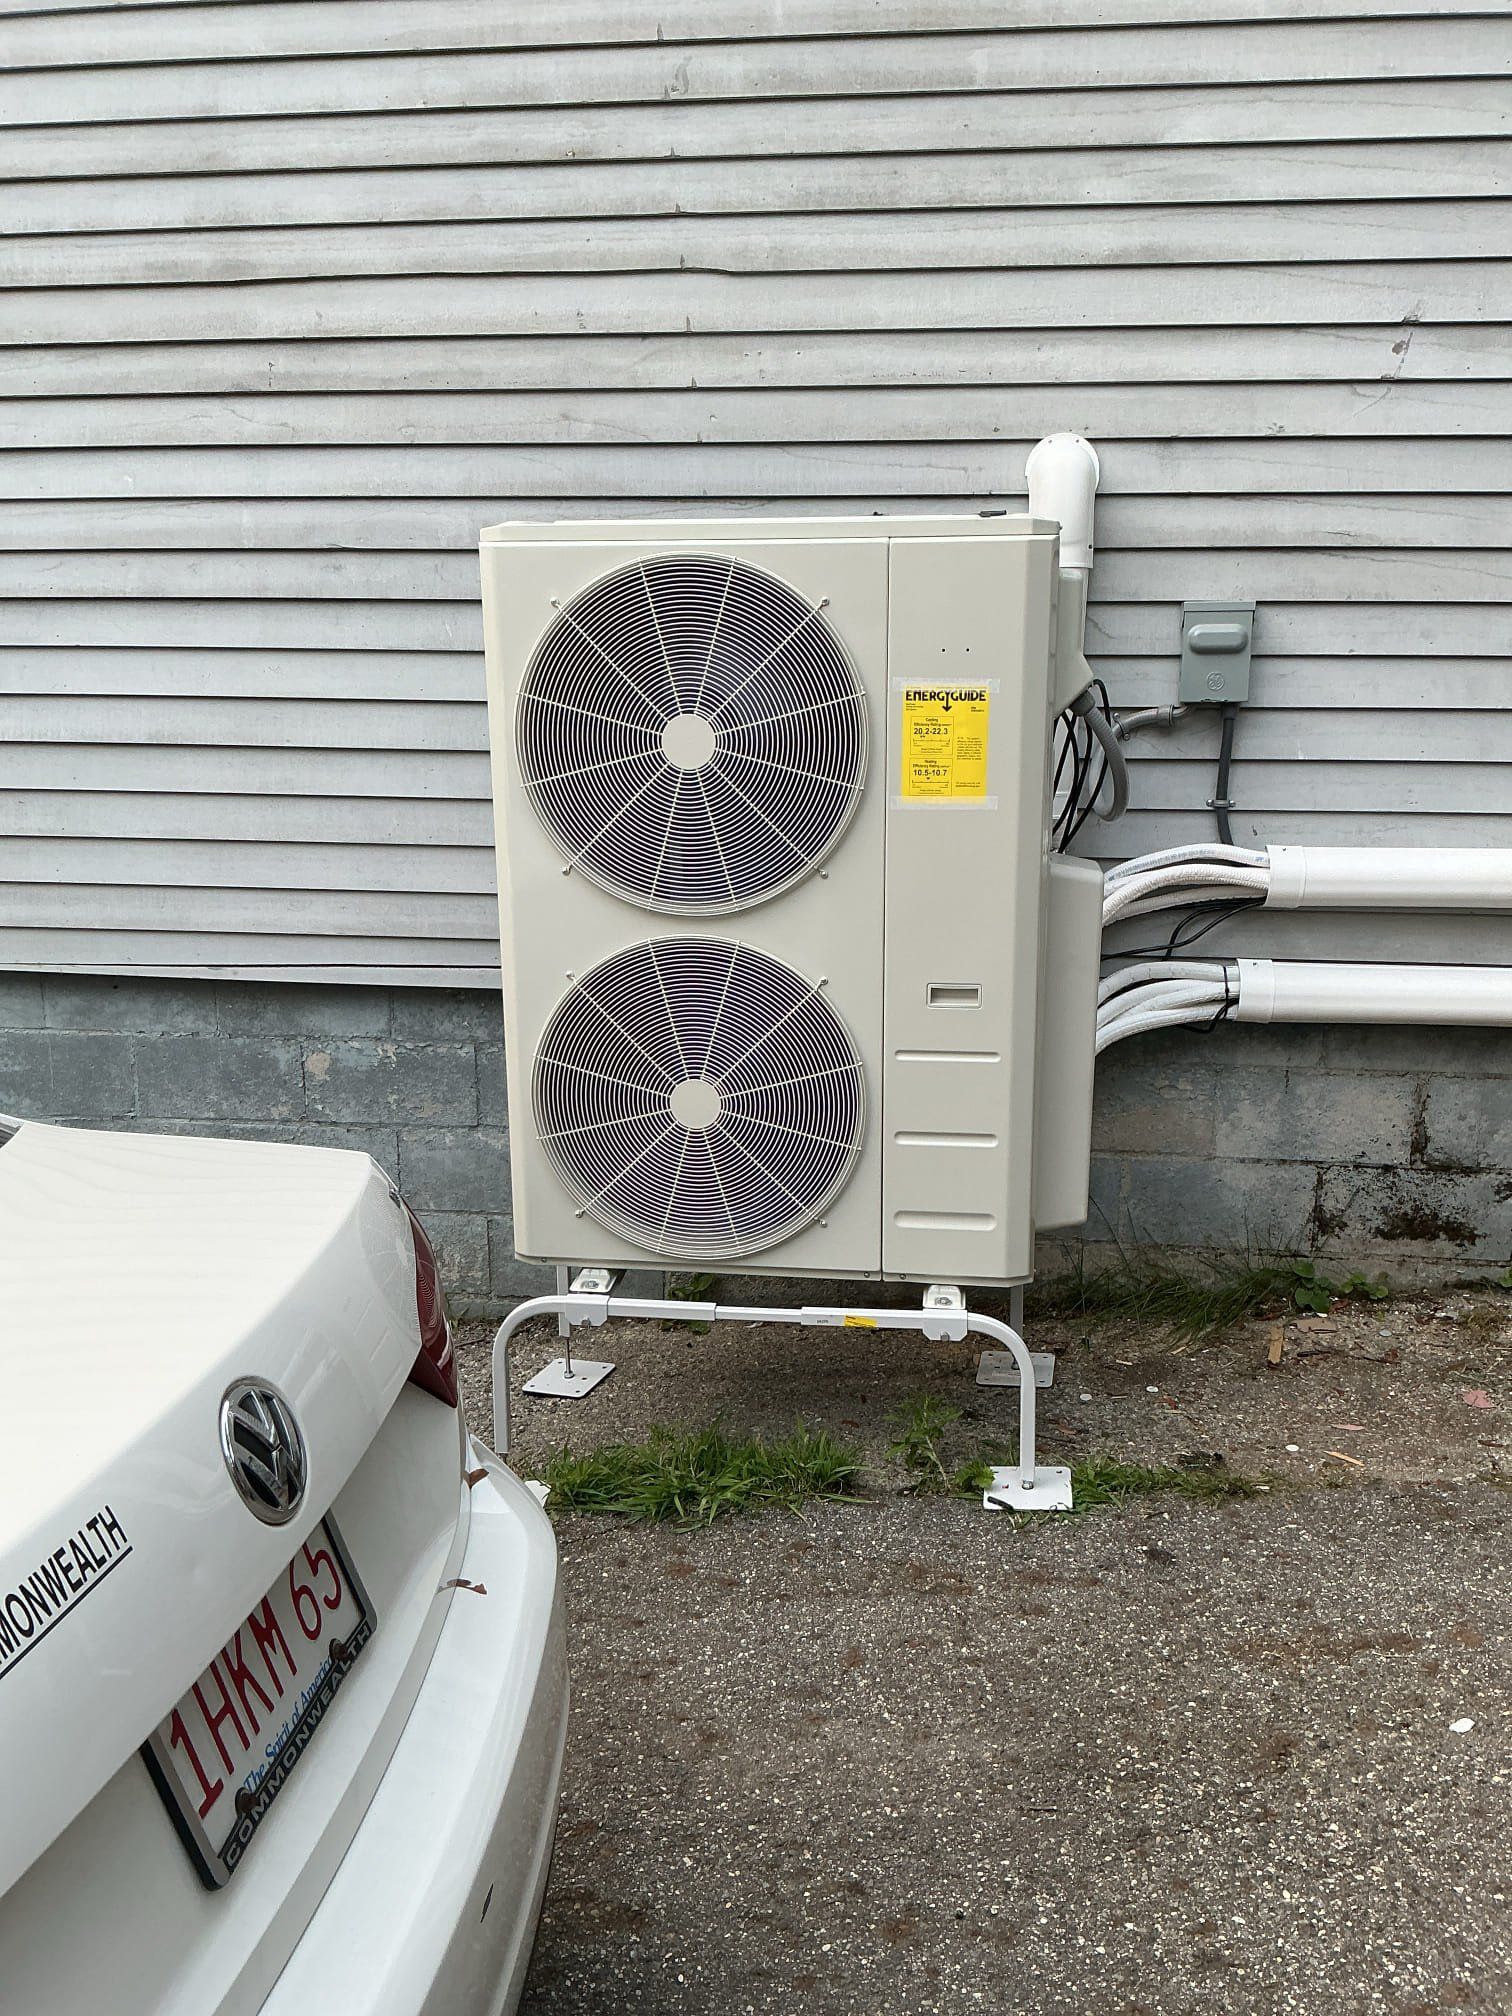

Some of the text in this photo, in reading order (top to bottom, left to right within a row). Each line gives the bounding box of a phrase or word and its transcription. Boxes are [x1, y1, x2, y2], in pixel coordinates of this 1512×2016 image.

[913, 727, 948, 735] 20.2-22.3
[913, 769, 948, 777] 10.5-10.7
[0, 1504, 128, 1664] MONWEALTH
[170, 1541, 342, 1819] 1HKM 65
